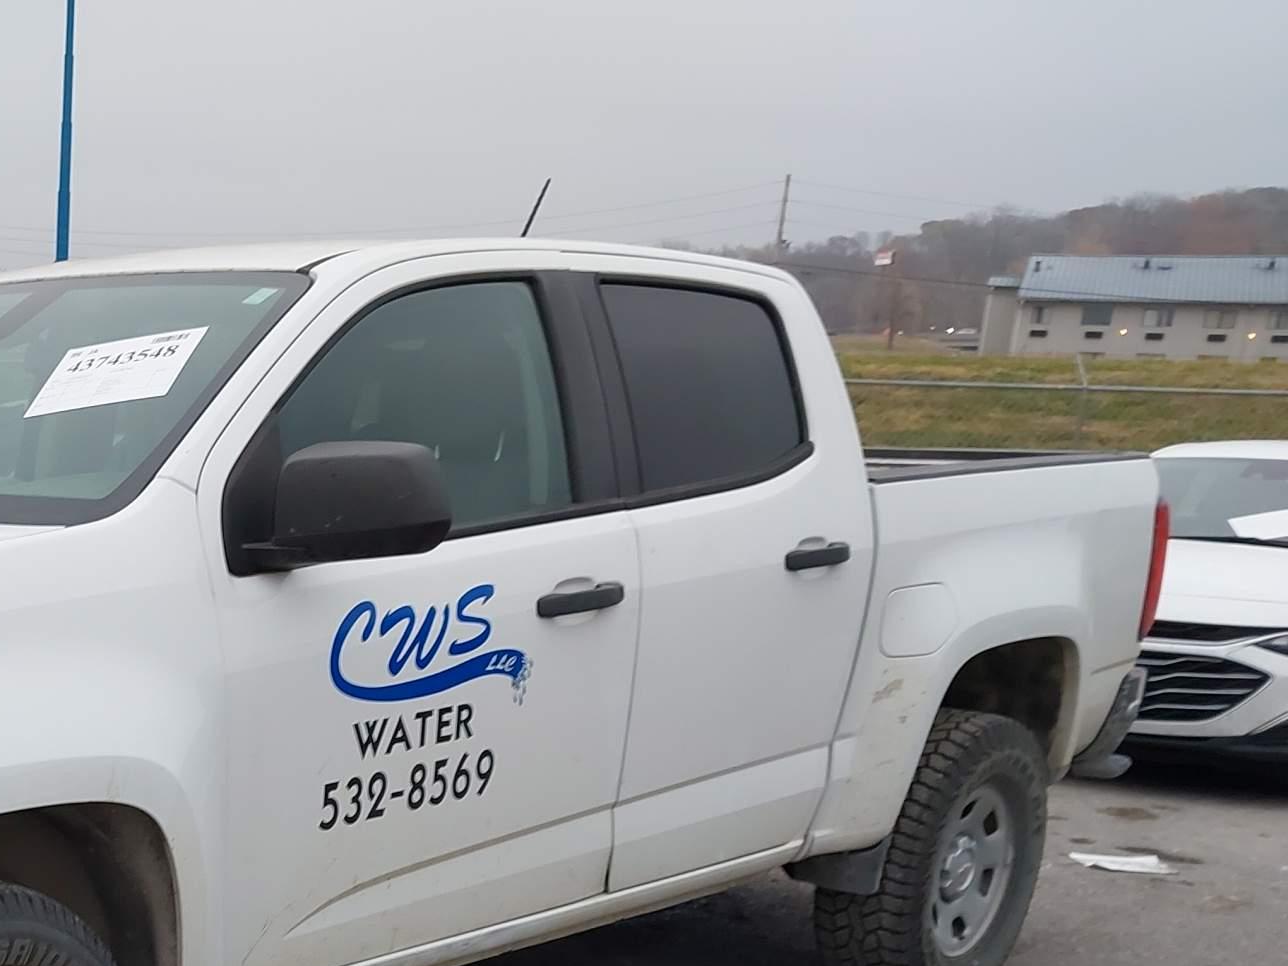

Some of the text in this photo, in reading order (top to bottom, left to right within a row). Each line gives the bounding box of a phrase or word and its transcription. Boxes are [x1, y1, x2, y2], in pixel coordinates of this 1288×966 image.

[66, 344, 180, 374] 43743548
[330, 584, 496, 702] CWS
[485, 652, 516, 672] LLC
[353, 703, 474, 760] WATER
[318, 749, 495, 831] 532-8569
